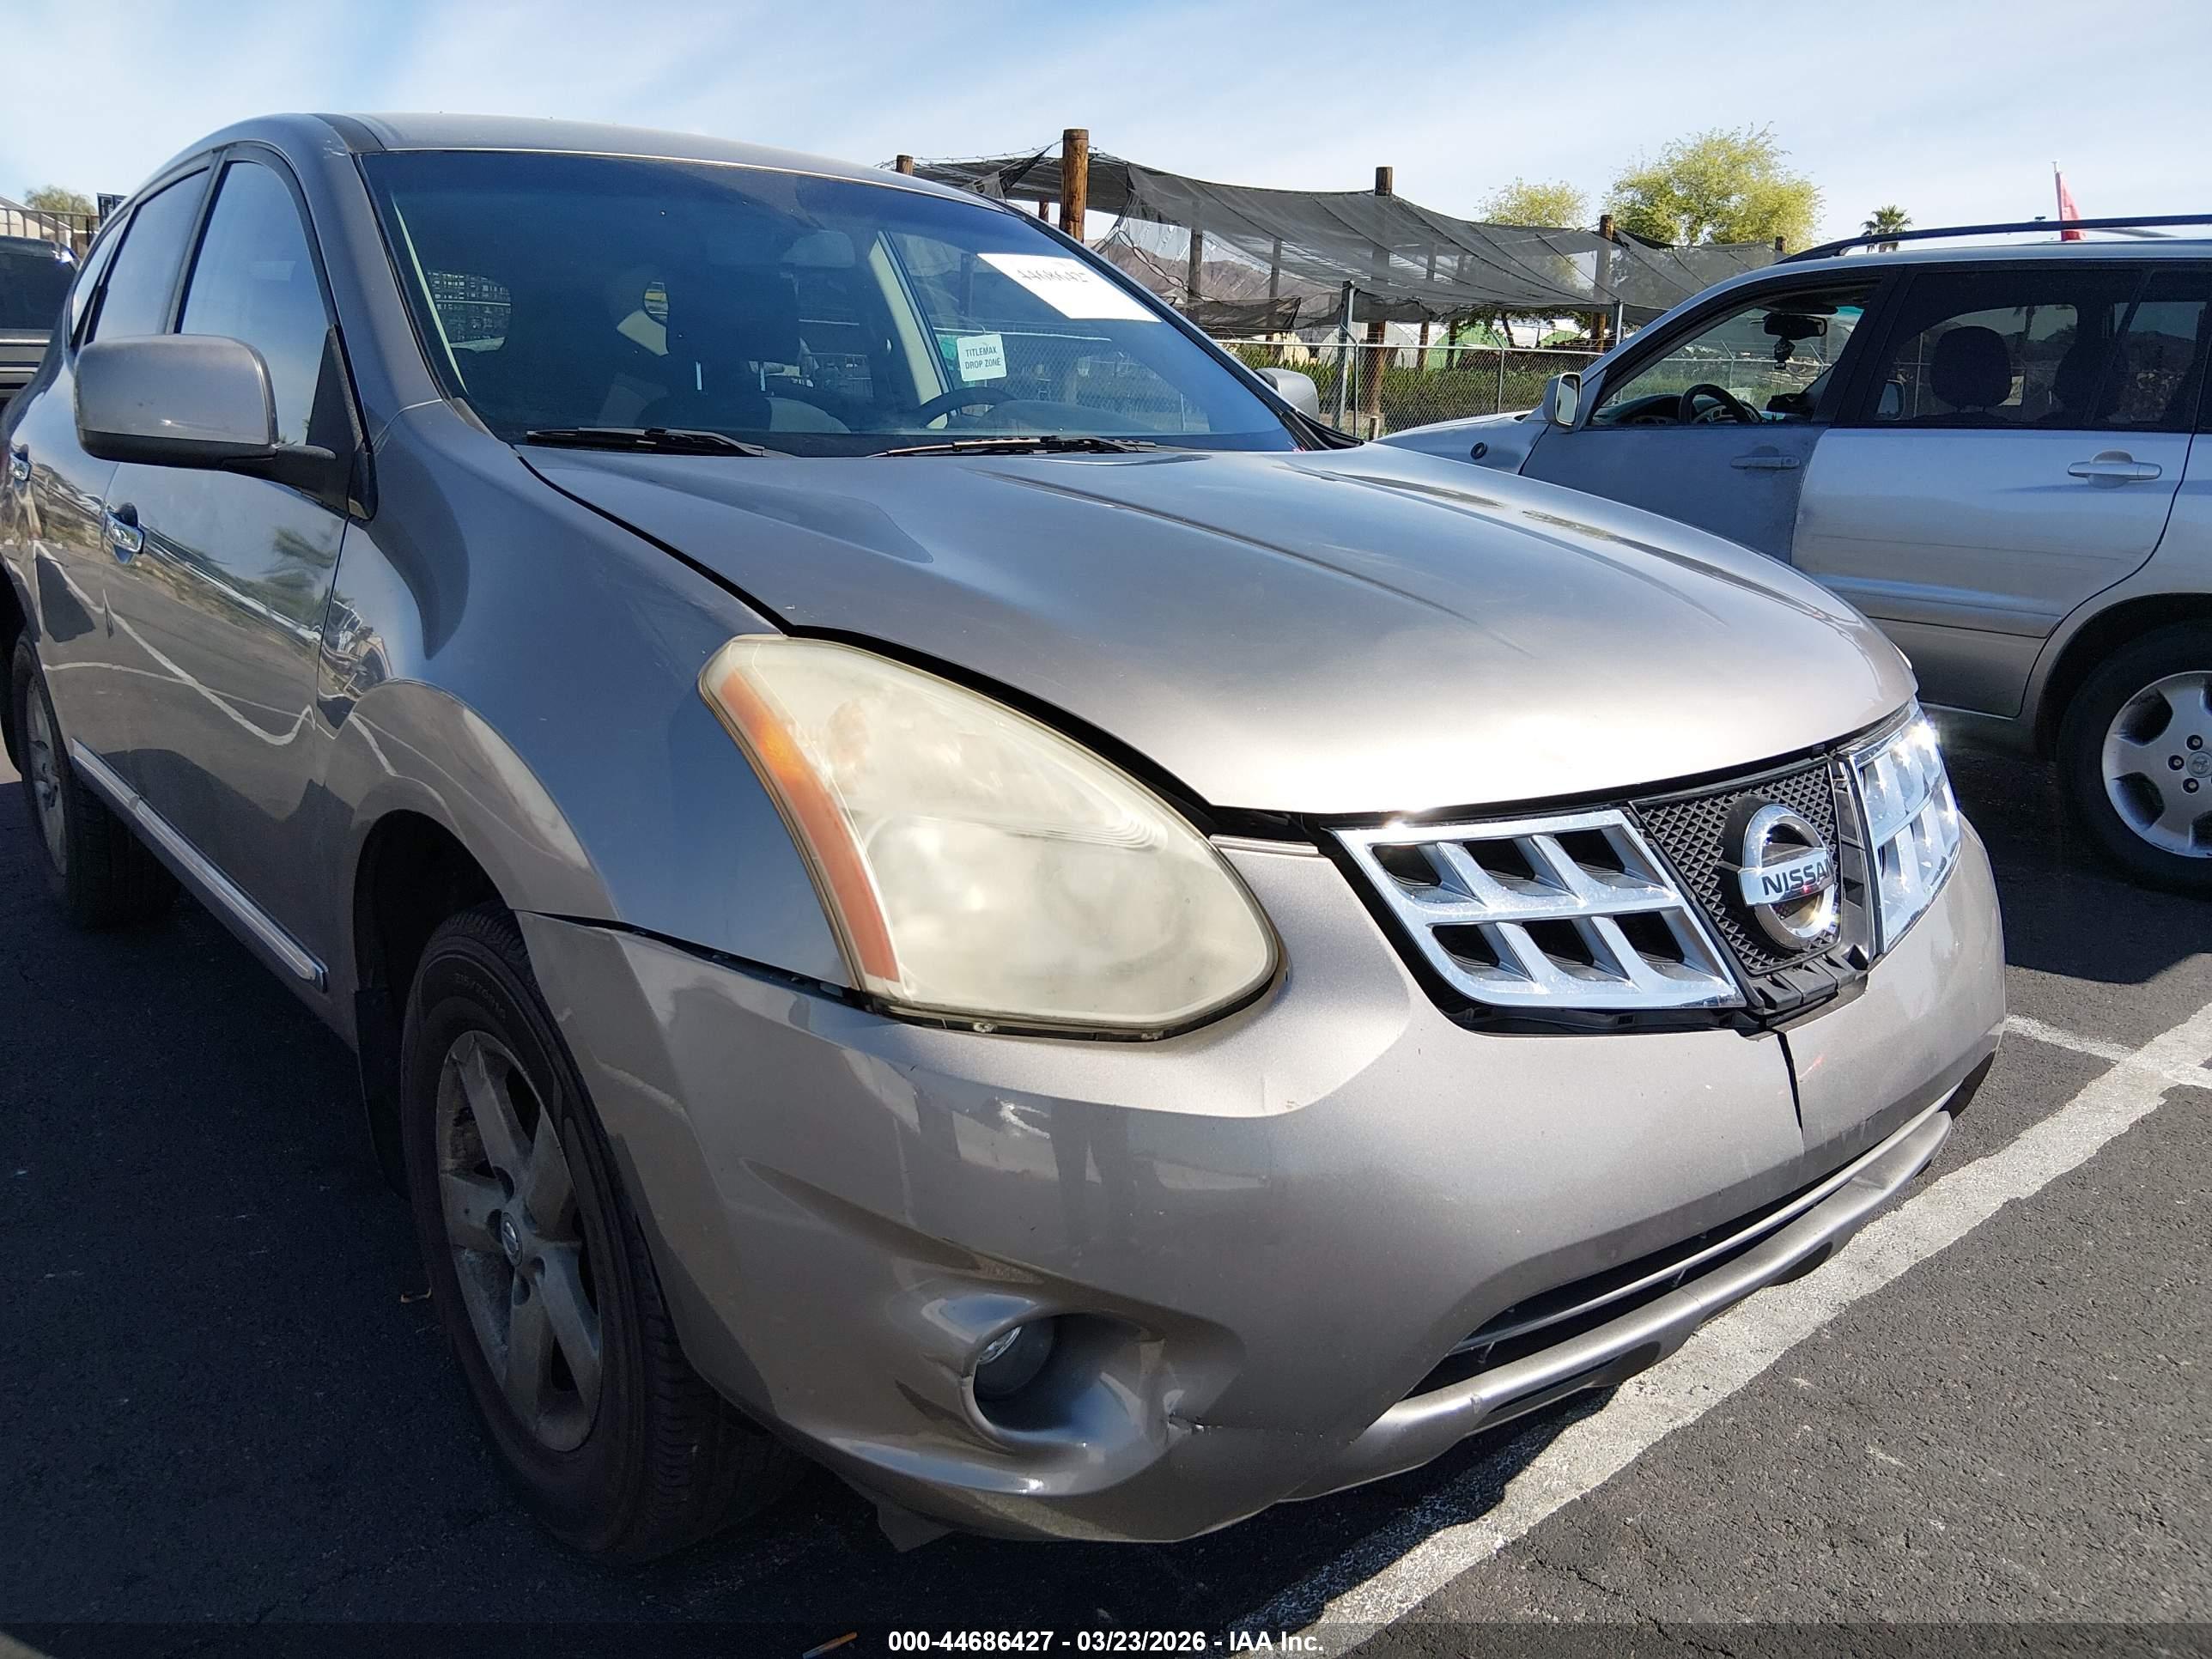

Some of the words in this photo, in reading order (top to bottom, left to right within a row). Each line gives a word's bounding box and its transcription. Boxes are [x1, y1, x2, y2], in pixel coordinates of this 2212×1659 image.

[966, 346, 997, 357] TITLEMAX
[964, 360, 983, 370] DROP
[985, 357, 1001, 368] ZONE
[1762, 860, 1834, 896] NISSAN
